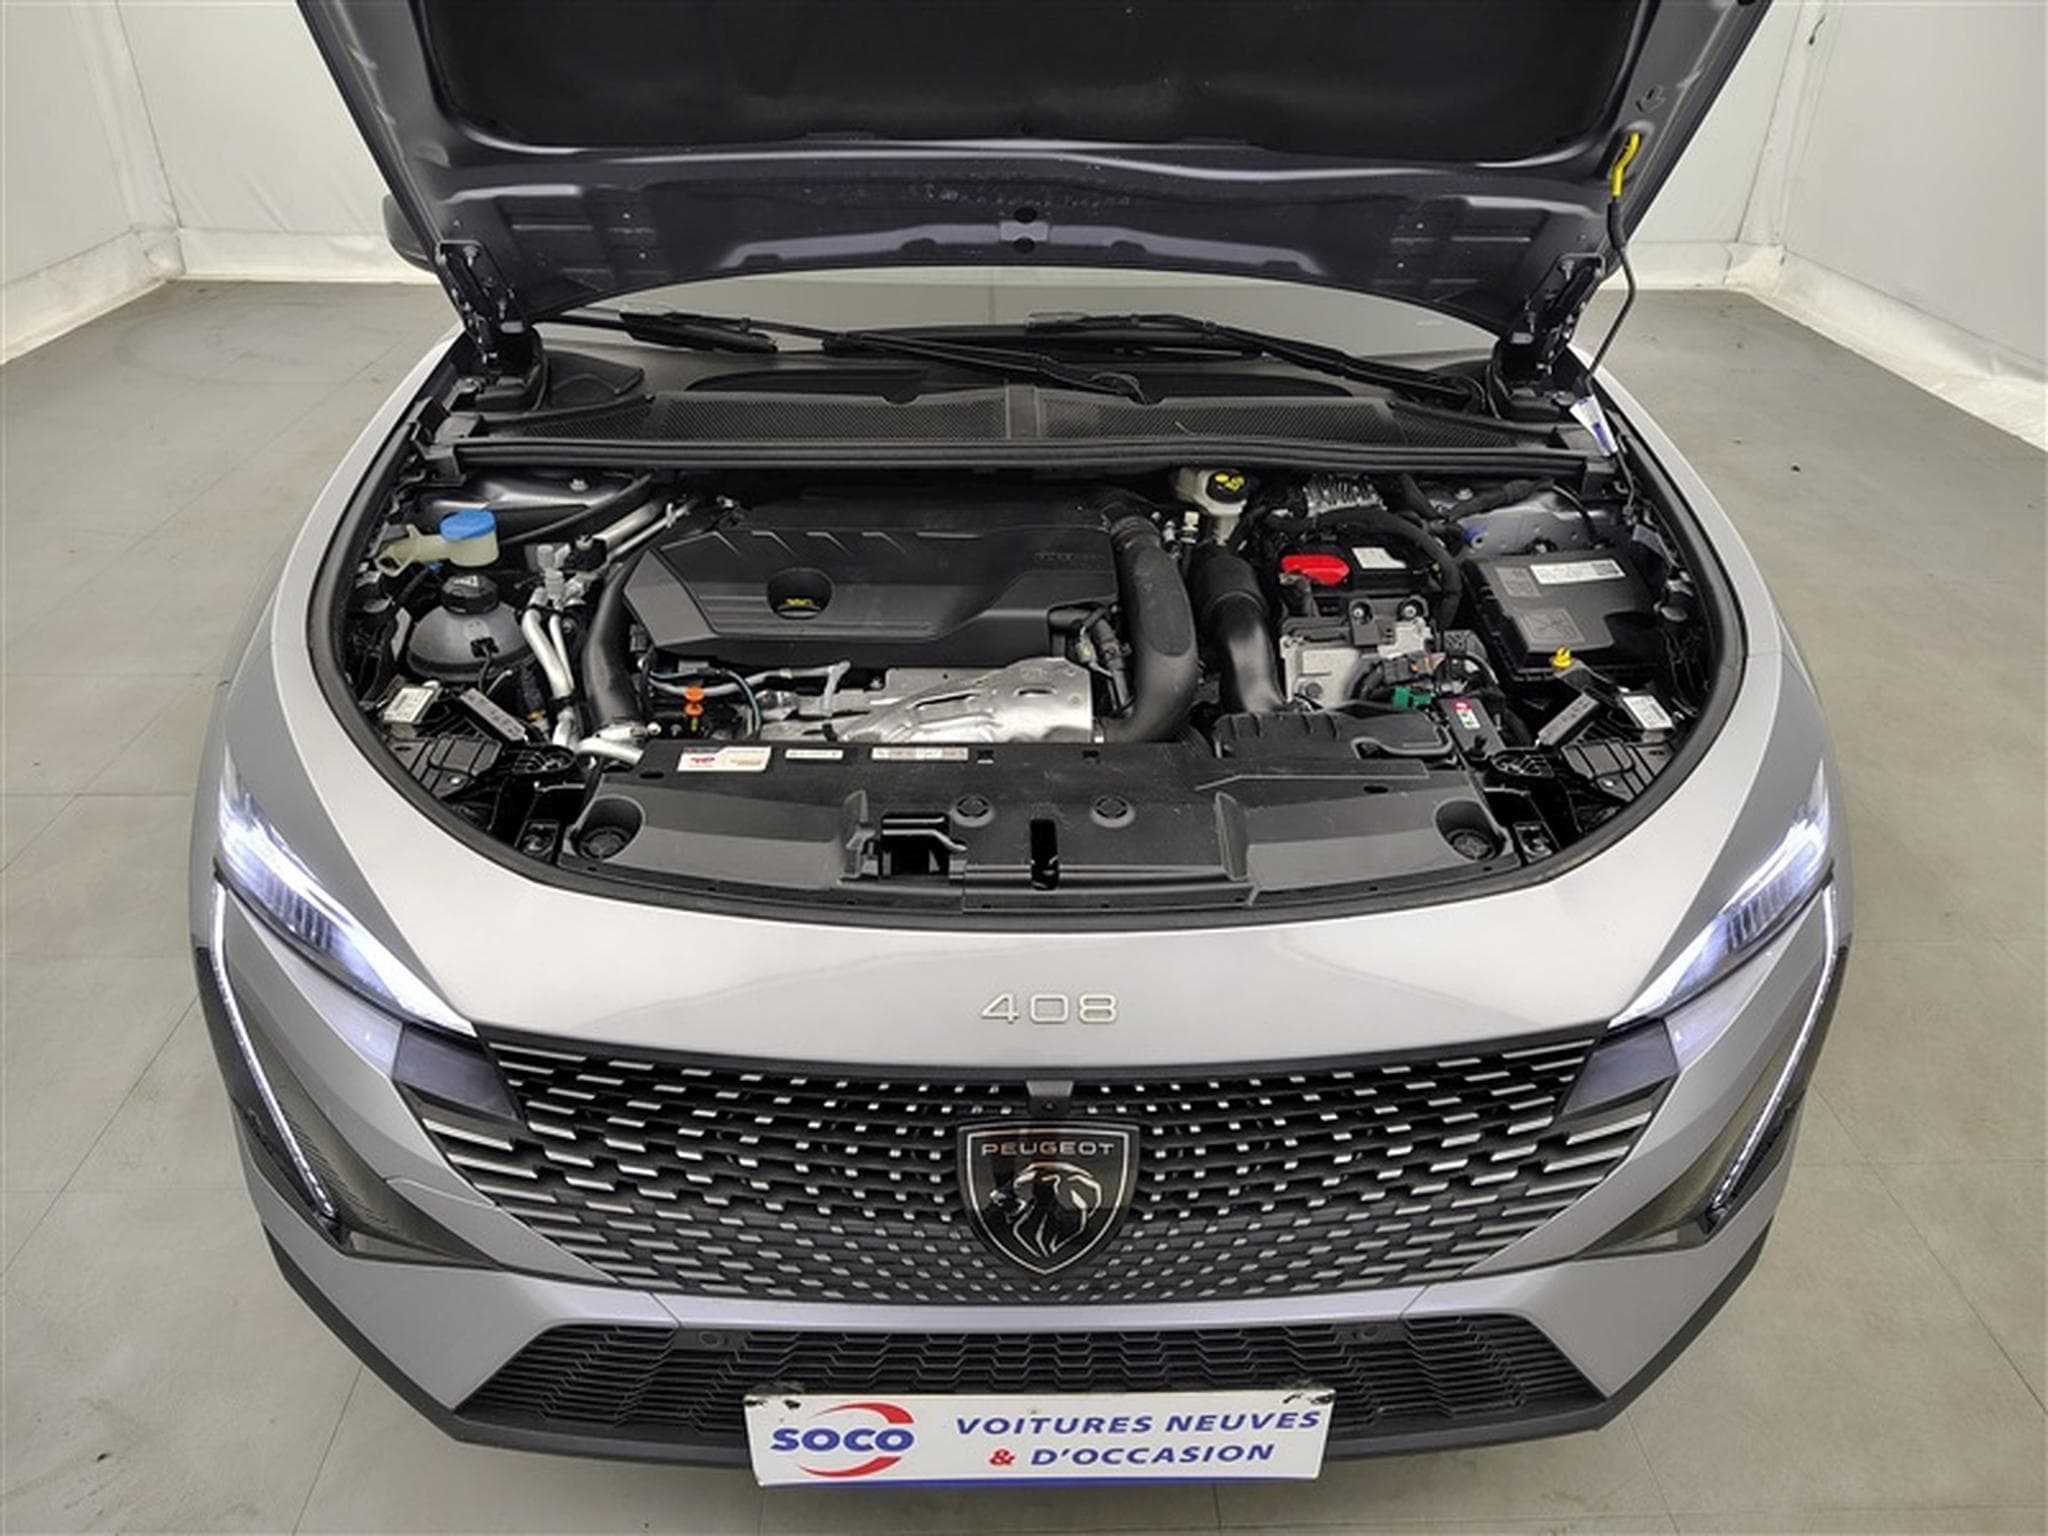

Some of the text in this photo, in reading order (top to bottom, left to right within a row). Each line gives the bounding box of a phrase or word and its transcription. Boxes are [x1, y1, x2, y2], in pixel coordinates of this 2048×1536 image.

[980, 993, 1119, 1024] 408
[981, 1141, 1116, 1156] PEUGEOT
[956, 1411, 1321, 1435] VOITURES NEUVES
[770, 1427, 915, 1452] SOCO
[989, 1443, 1275, 1467] & D'OCCASION
